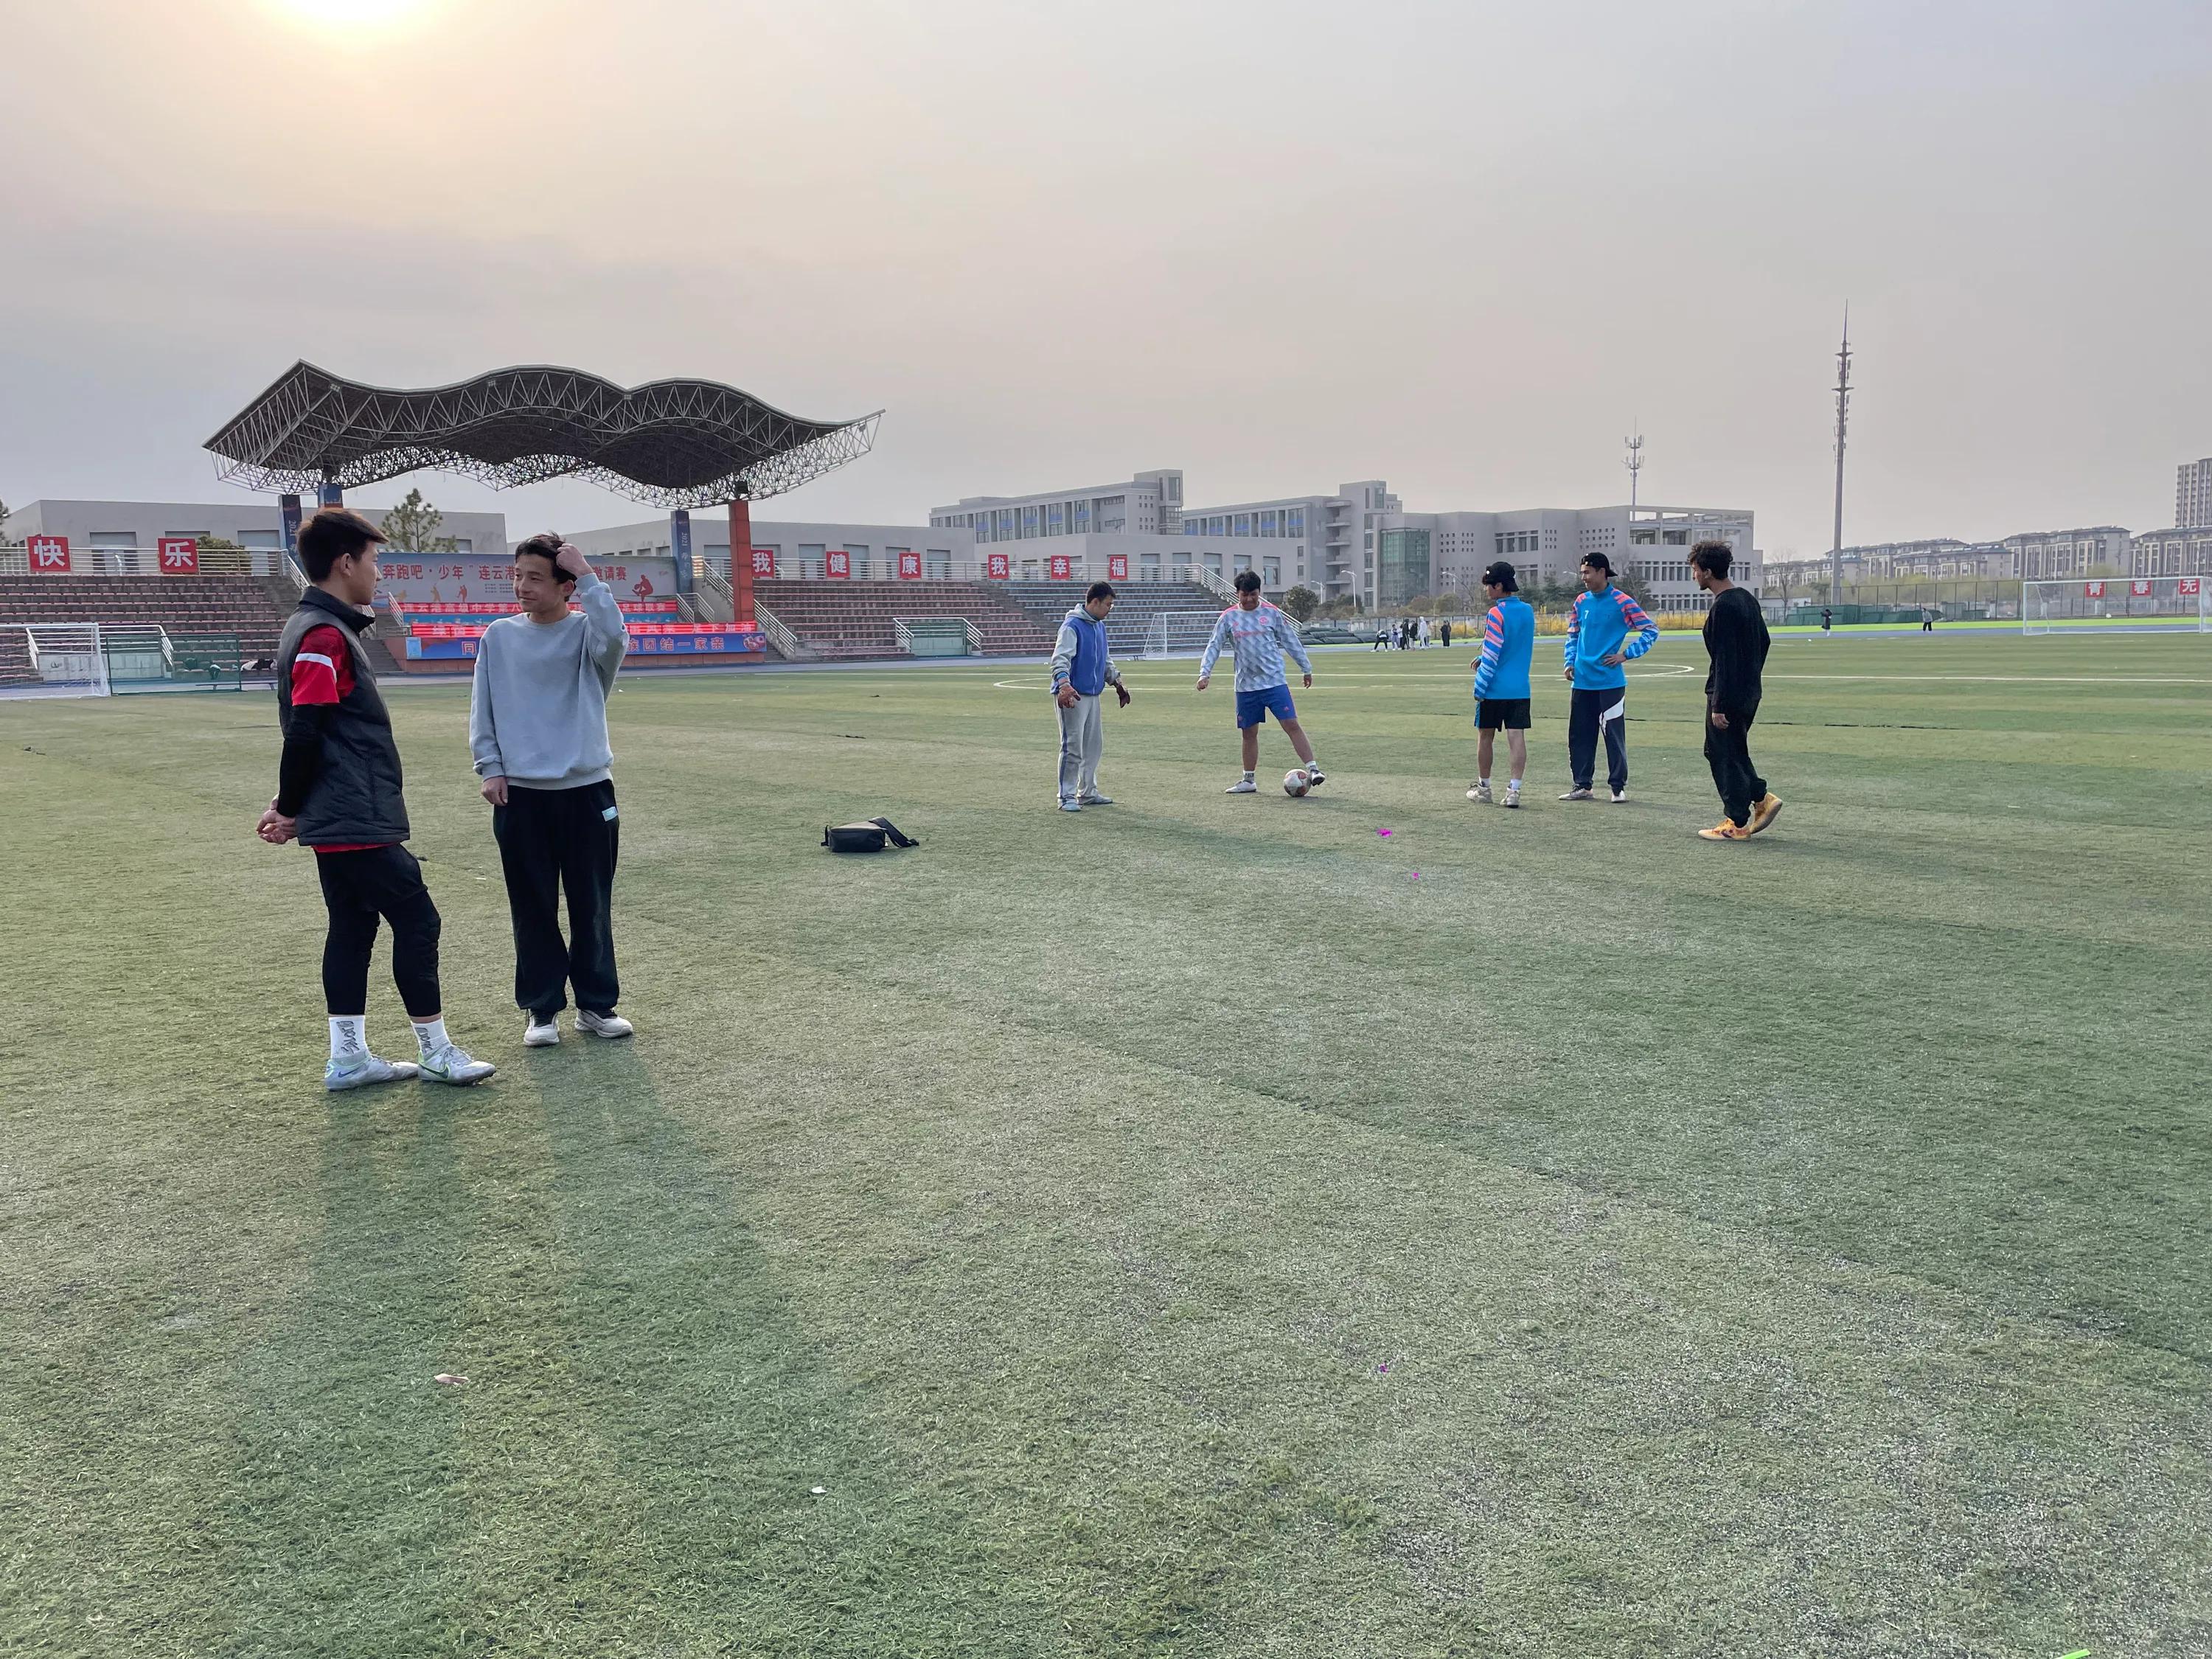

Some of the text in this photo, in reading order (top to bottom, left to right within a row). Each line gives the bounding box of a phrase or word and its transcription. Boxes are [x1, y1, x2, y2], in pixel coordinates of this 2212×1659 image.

[34, 539, 193, 567] 快 乐
[752, 552, 918, 574] 我 健 康
[991, 557, 1125, 576] 我 幸 福
[1585, 610, 1590, 619] 7
[462, 641, 477, 655] 同
